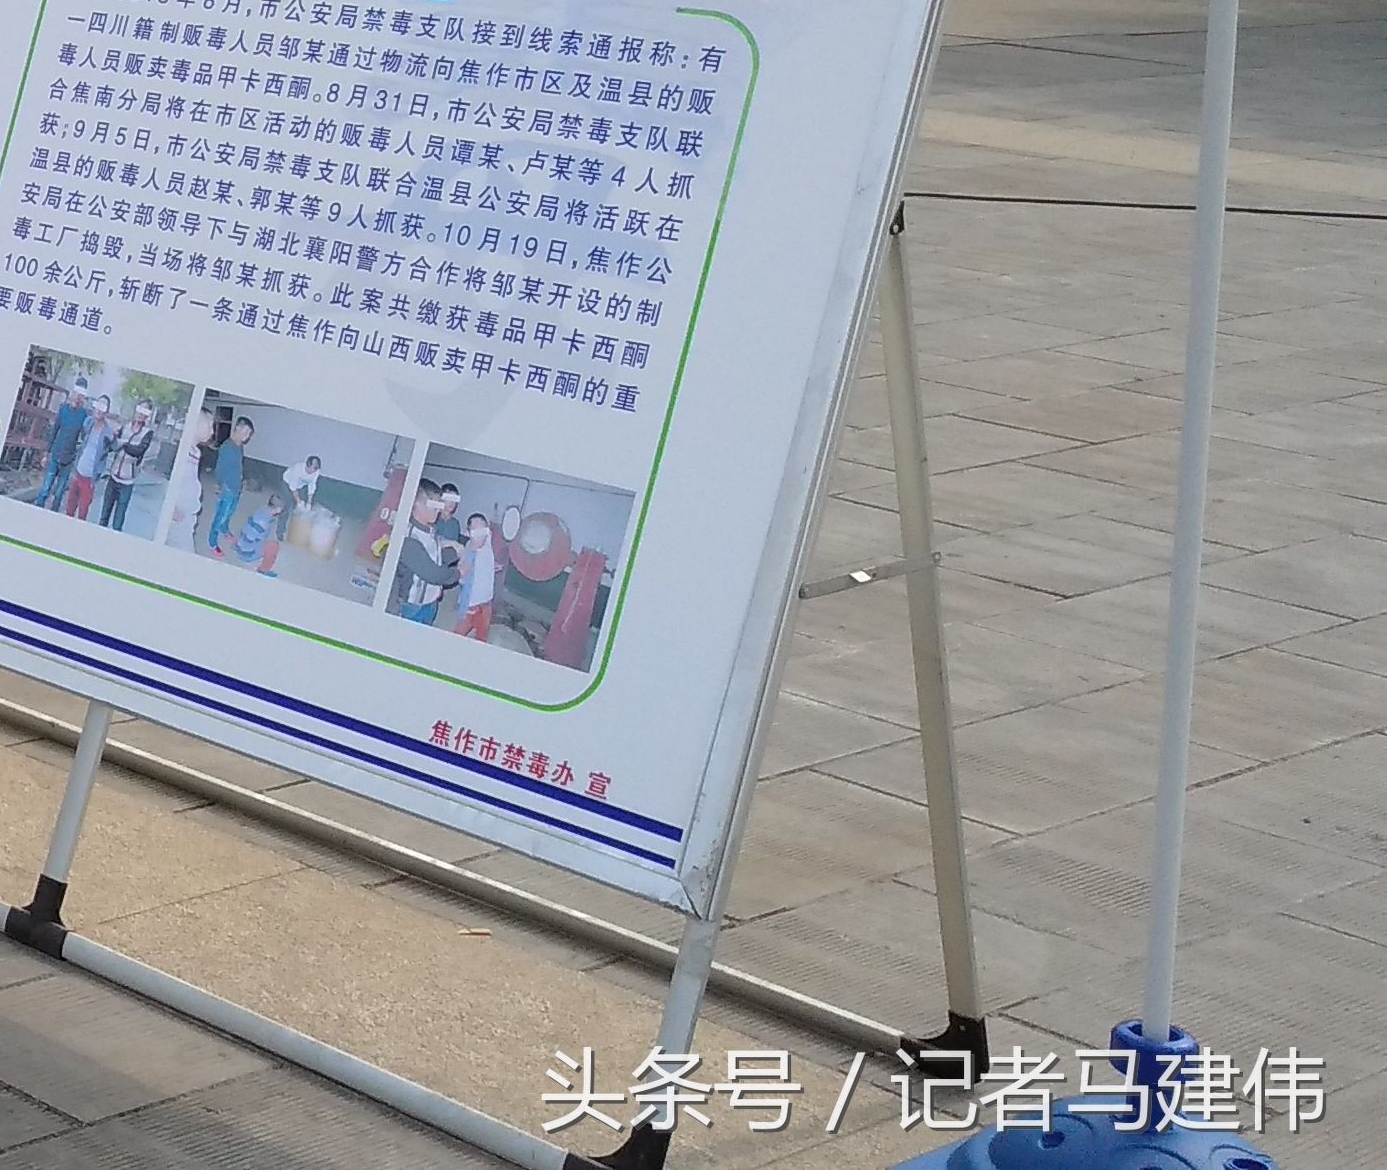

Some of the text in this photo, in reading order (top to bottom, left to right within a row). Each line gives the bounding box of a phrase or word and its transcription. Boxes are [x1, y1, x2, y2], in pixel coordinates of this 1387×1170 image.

[57, 42, 705, 159] 毒人员贩卖毒品甲卡西酮。8月31日，市公安局禁毒支队联
[67, 11, 717, 116] 一四川籍制贩毒人员邹某通过物流向焦作市区及温县的贩
[39, 112, 684, 243] 获；9月5日，市公安局禁毒支队联合温县公安局将活跃在
[48, 77, 696, 201] 合焦南分局将在市区活动的贩毒人员谭某、卢某等4人抓
[21, 181, 663, 327] 安局在公安部领导下与湖北襄阳警方合作将邹某开设的制
[29, 146, 673, 285] 温县的贩毒人员赵某、郭某等9人抓获。10月19日，焦作公
[4, 254, 641, 414] 100余公斤，斩断了一条通过焦作向山西贩卖甲卡西酮的重
[12, 216, 651, 371] 毒工厂捣毁，当场将邹某抓获。此案共缴获毒品甲卡西酮
[429, 720, 612, 800] 焦作市禁毒办 宣
